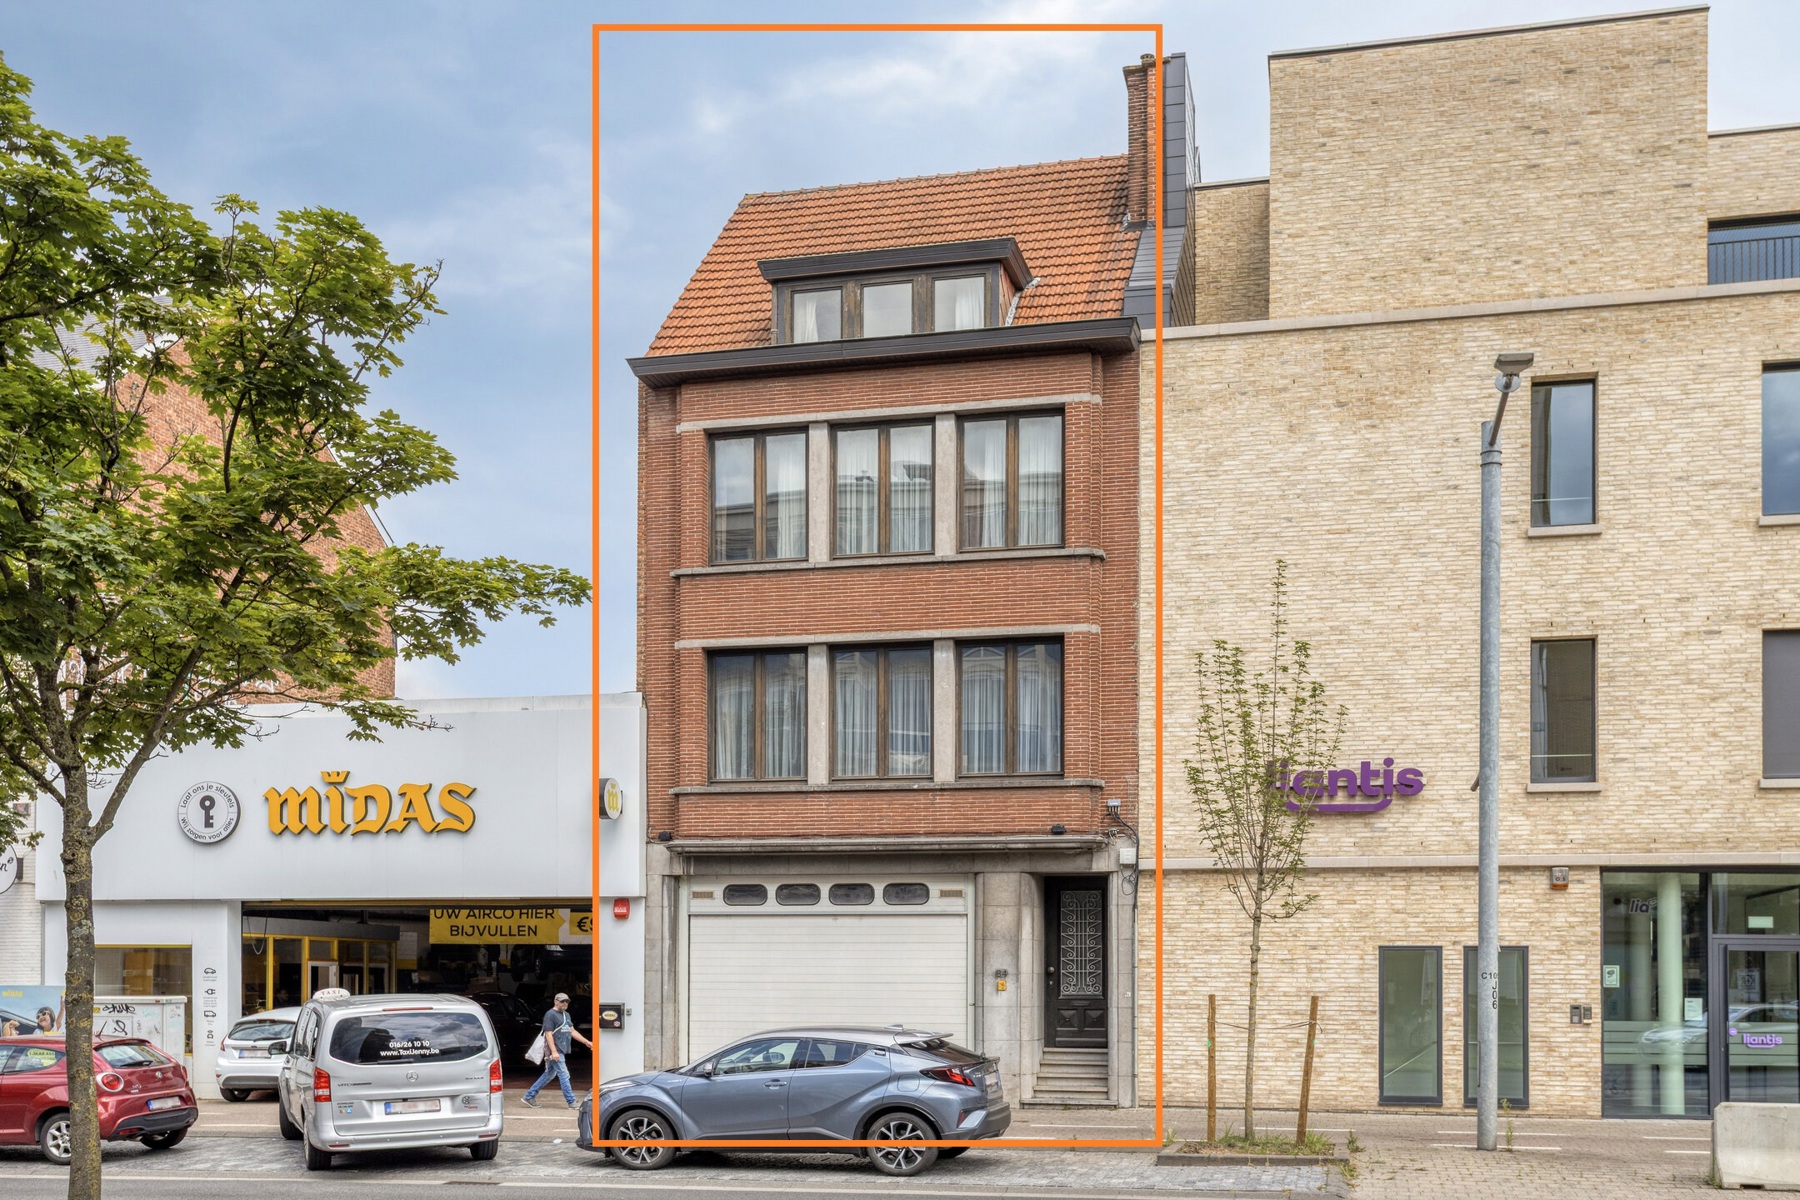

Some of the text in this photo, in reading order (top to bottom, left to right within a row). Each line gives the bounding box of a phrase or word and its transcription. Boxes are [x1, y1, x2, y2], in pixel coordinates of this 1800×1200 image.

[180, 783, 235, 808] Laat ons je sleutels
[181, 817, 234, 840] Wij zorgen voor alles
[433, 908, 555, 919] UW AIRCO HIER
[450, 925, 538, 937] BIJVULLEN
[389, 1041, 412, 1049] 016/26
[423, 1040, 430, 1048] 10
[1743, 1033, 1783, 1045] liantis
